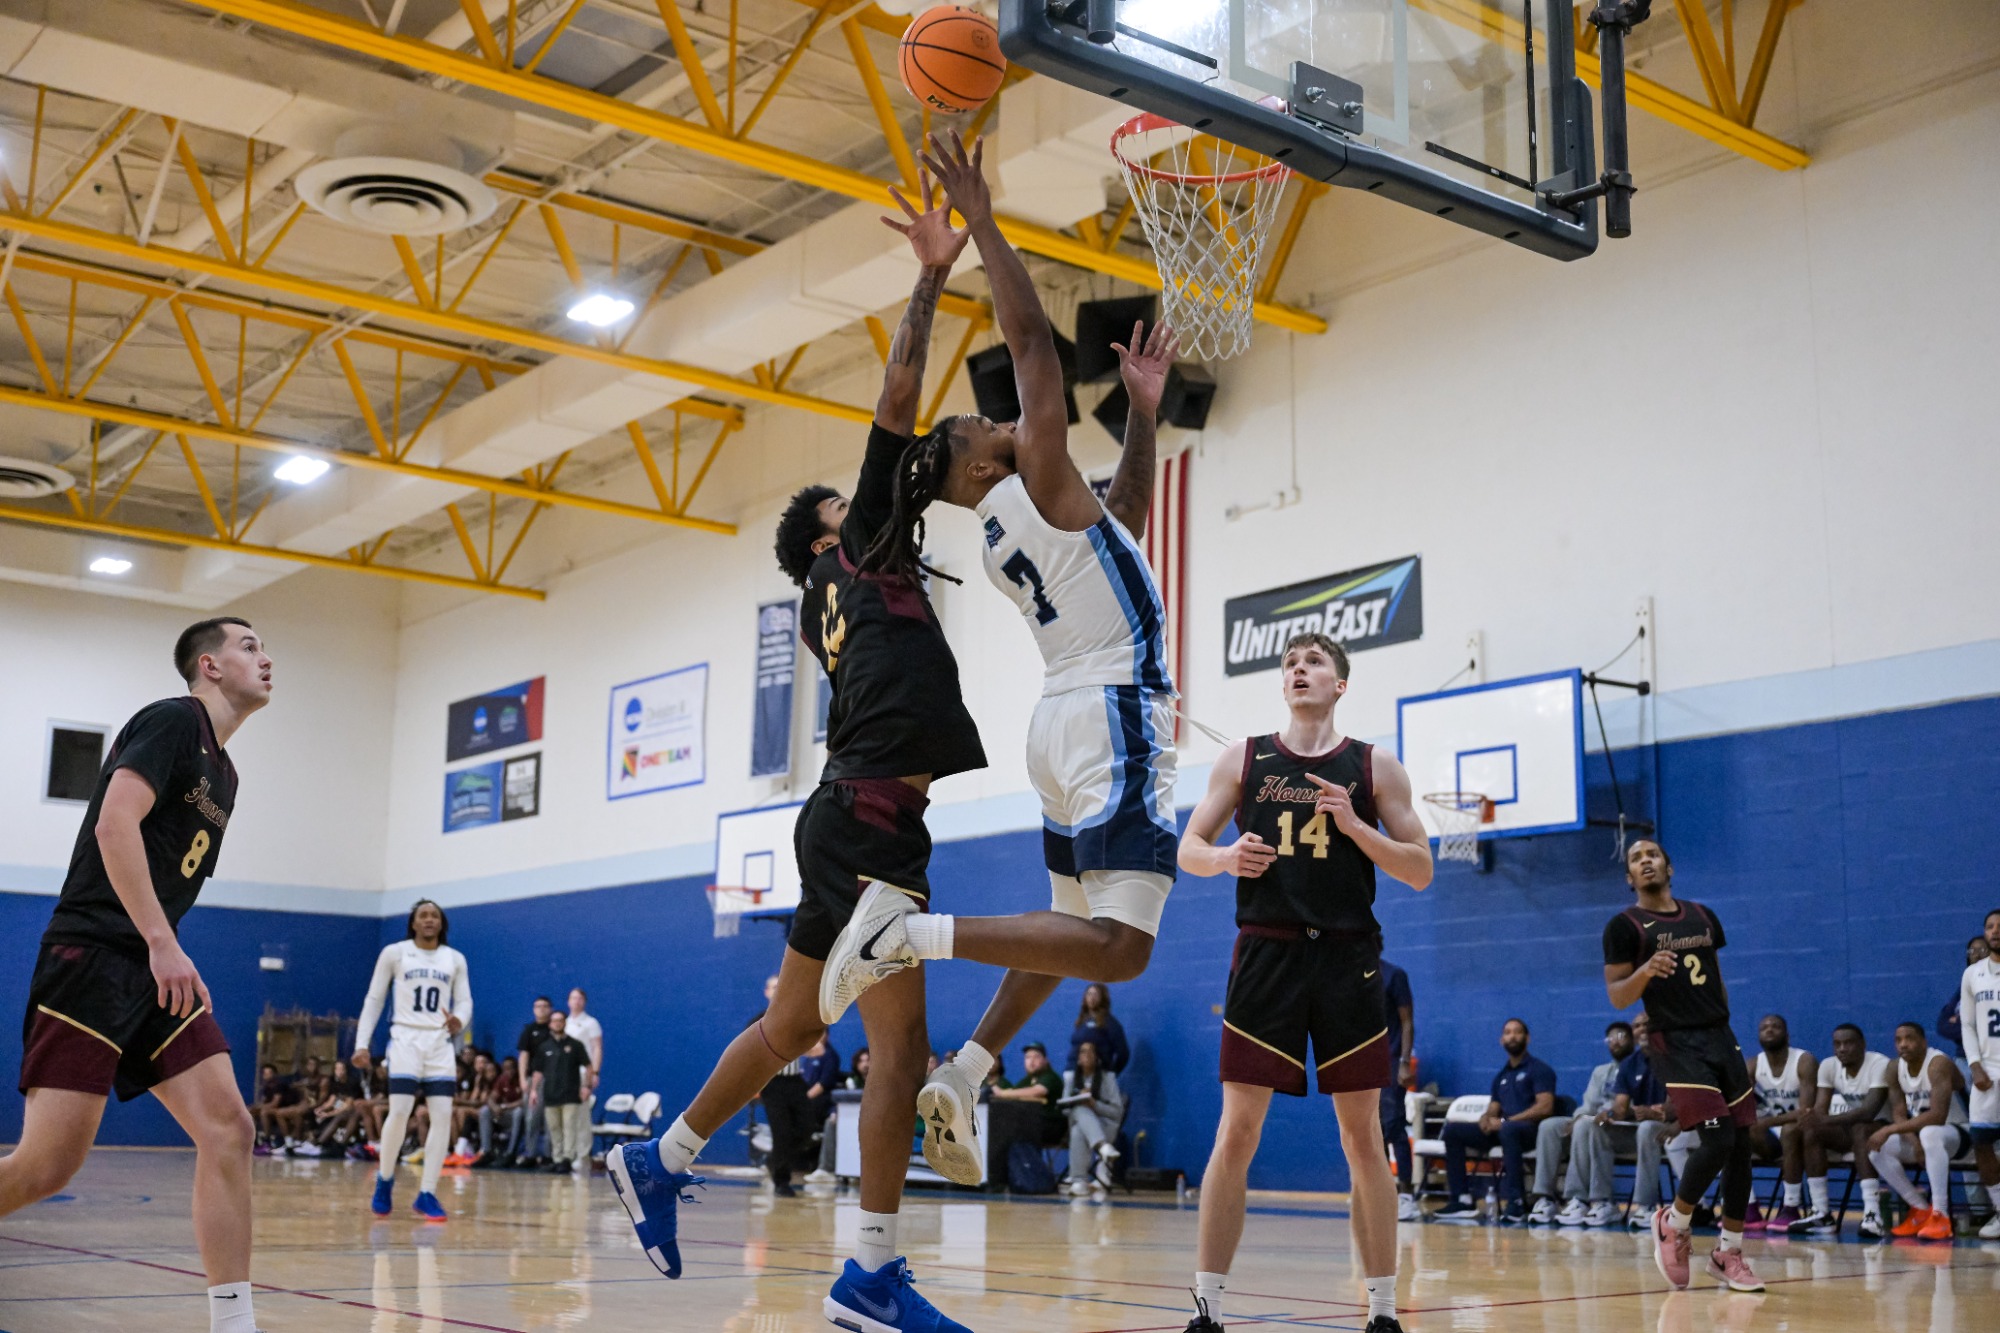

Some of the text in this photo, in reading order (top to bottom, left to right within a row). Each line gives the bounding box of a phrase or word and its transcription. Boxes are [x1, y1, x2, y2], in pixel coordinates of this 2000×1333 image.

[1000, 547, 1060, 627] 7
[181, 829, 210, 879] 8
[1277, 811, 1330, 859] 14
[1683, 953, 1707, 986] 2
[413, 985, 440, 1013] 10
